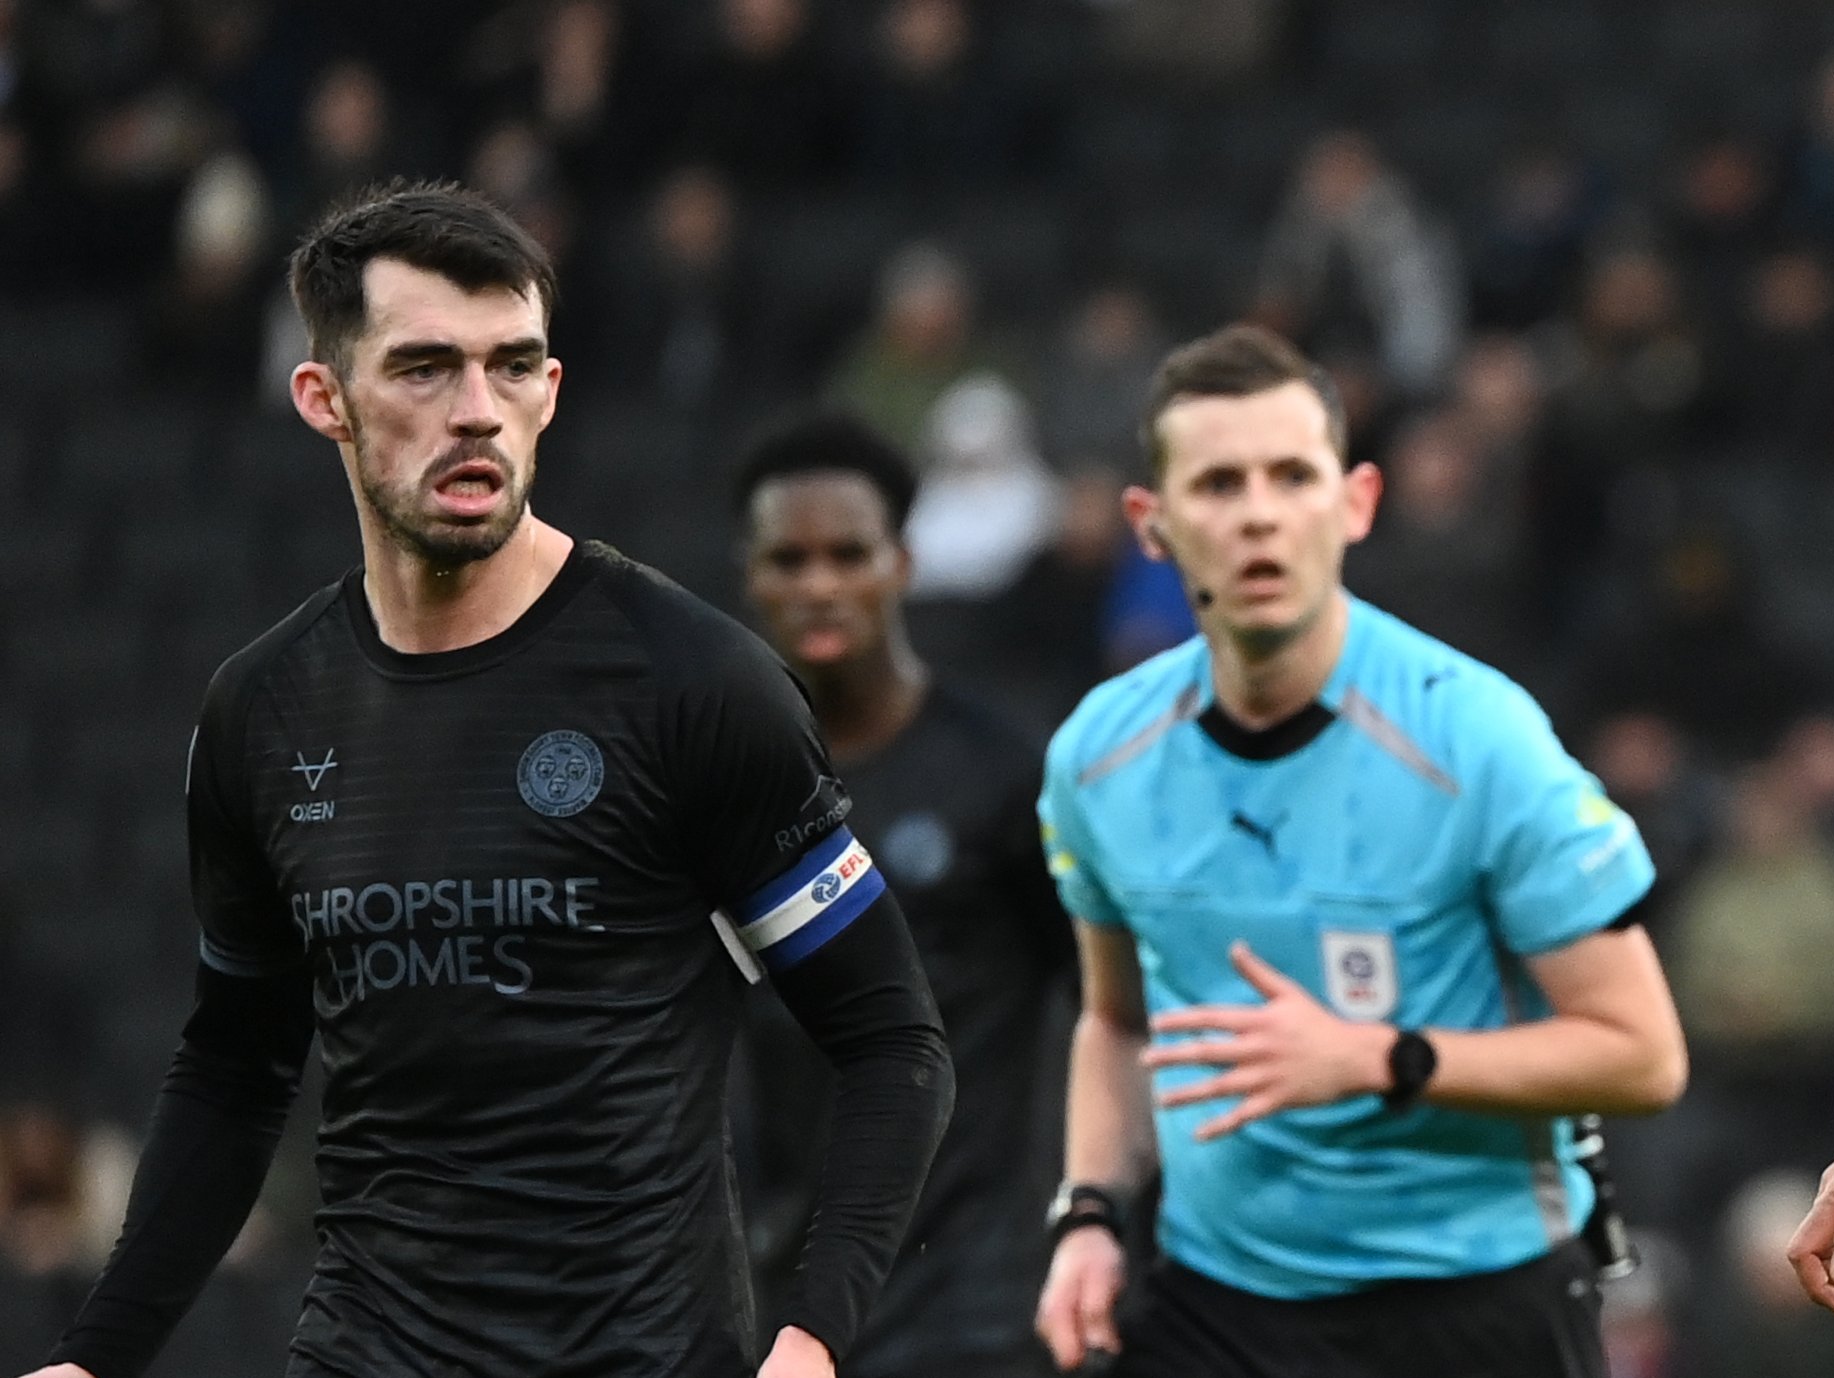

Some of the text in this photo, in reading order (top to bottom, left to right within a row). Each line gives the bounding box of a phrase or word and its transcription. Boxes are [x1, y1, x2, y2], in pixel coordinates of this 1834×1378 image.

[289, 801, 335, 822] OXEN
[838, 853, 864, 879] EFL
[291, 877, 606, 952] SHROPSHIRE
[322, 934, 534, 1003] HOMES
